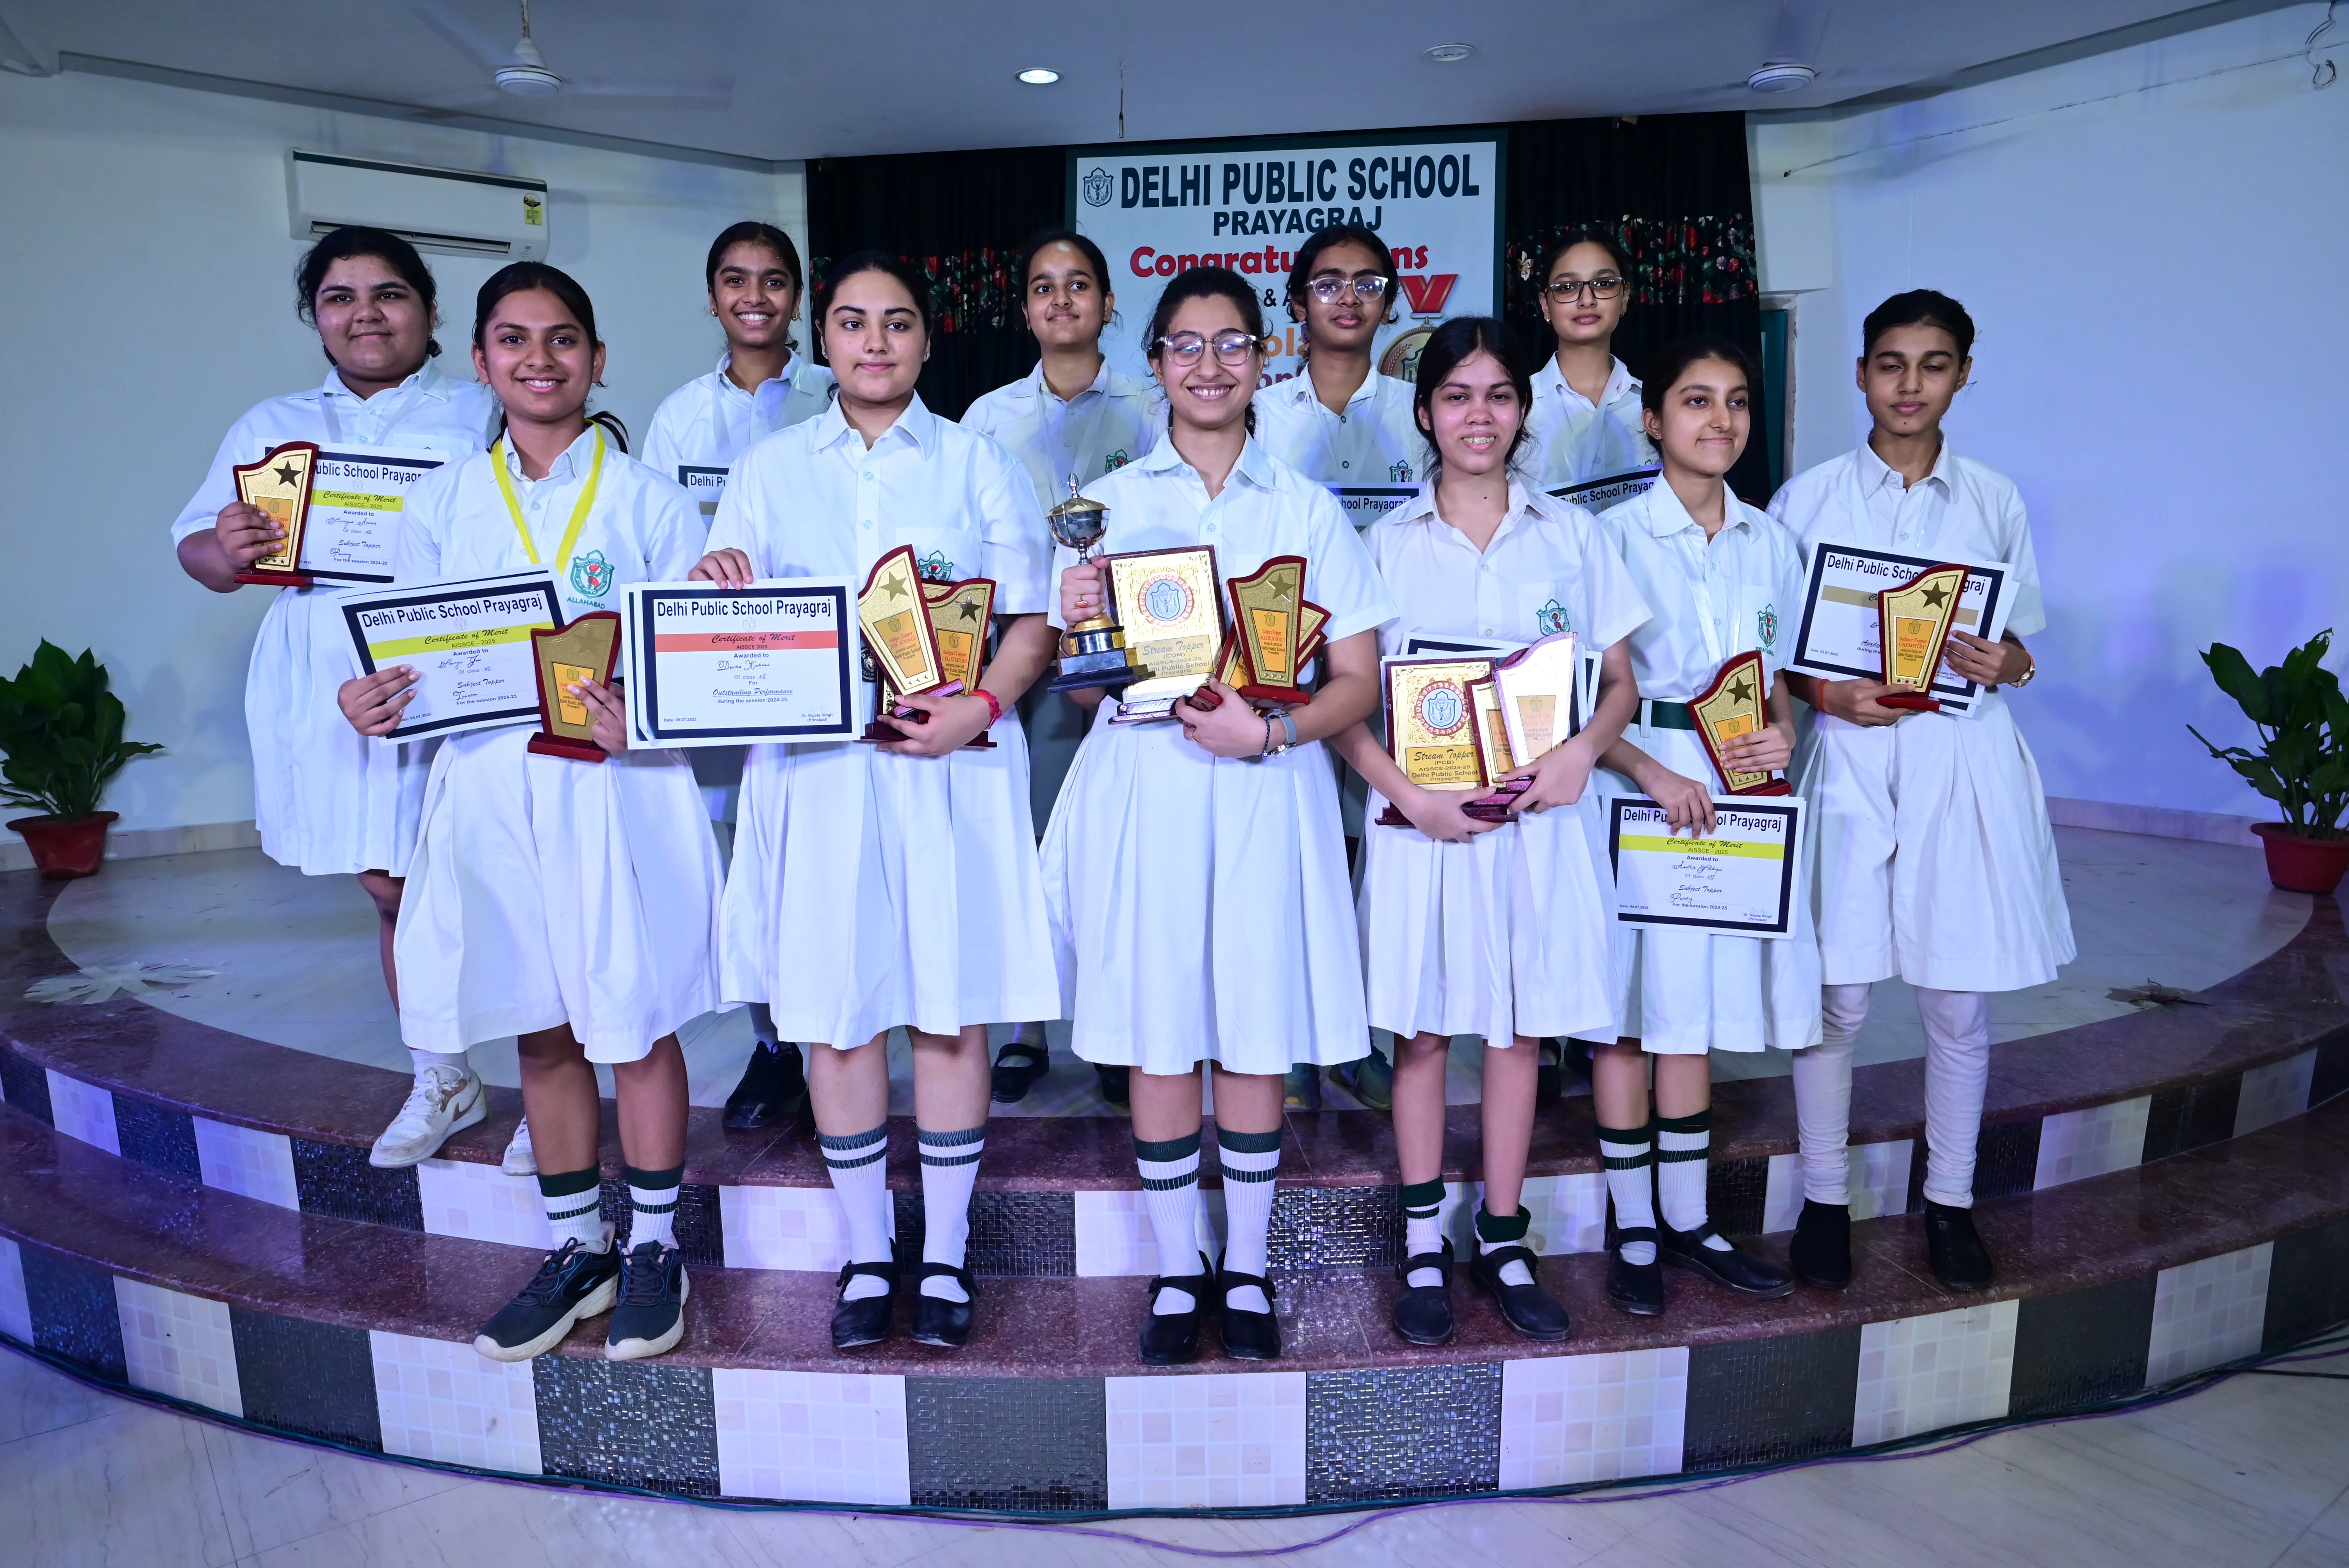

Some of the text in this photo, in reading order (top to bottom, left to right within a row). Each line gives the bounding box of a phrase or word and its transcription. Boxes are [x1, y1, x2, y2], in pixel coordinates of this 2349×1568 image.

[1121, 164, 1210, 208] DELHI
[1223, 159, 1337, 205] PUBLIC
[1347, 154, 1479, 201] SCHOOL
[1214, 206, 1381, 236] PRAYAGRAJ
[1130, 245, 1428, 278] Congratuns
[315, 462, 421, 485] ublic School Prayagr
[691, 475, 713, 487] Delhi
[323, 491, 361, 501] Certificate
[374, 495, 396, 503] Merit
[1590, 485, 1620, 502] School
[1827, 554, 1919, 581] Delhi Public Scho
[567, 596, 605, 609] ALLAHABAD
[657, 599, 831, 618] Delhi Public School Prayagraj
[361, 593, 543, 628] Delhi Public School Prayagraj
[424, 628, 509, 645] Certificate of Merit
[711, 633, 795, 644] Certificate of Merit
[899, 636, 916, 645] SCIENCE
[1142, 641, 1204, 656] Stream Topper
[1148, 656, 1201, 666] AISSCE-2024-25
[754, 688, 793, 696] Performance
[410, 712, 432, 720] 05.07.2025
[1414, 749, 1474, 761] Stream Topper
[1624, 808, 1650, 821] Delhi
[1730, 814, 1781, 832] Prayagraj
[1666, 837, 1706, 847] Certificate
[1719, 840, 1743, 848] Merit
